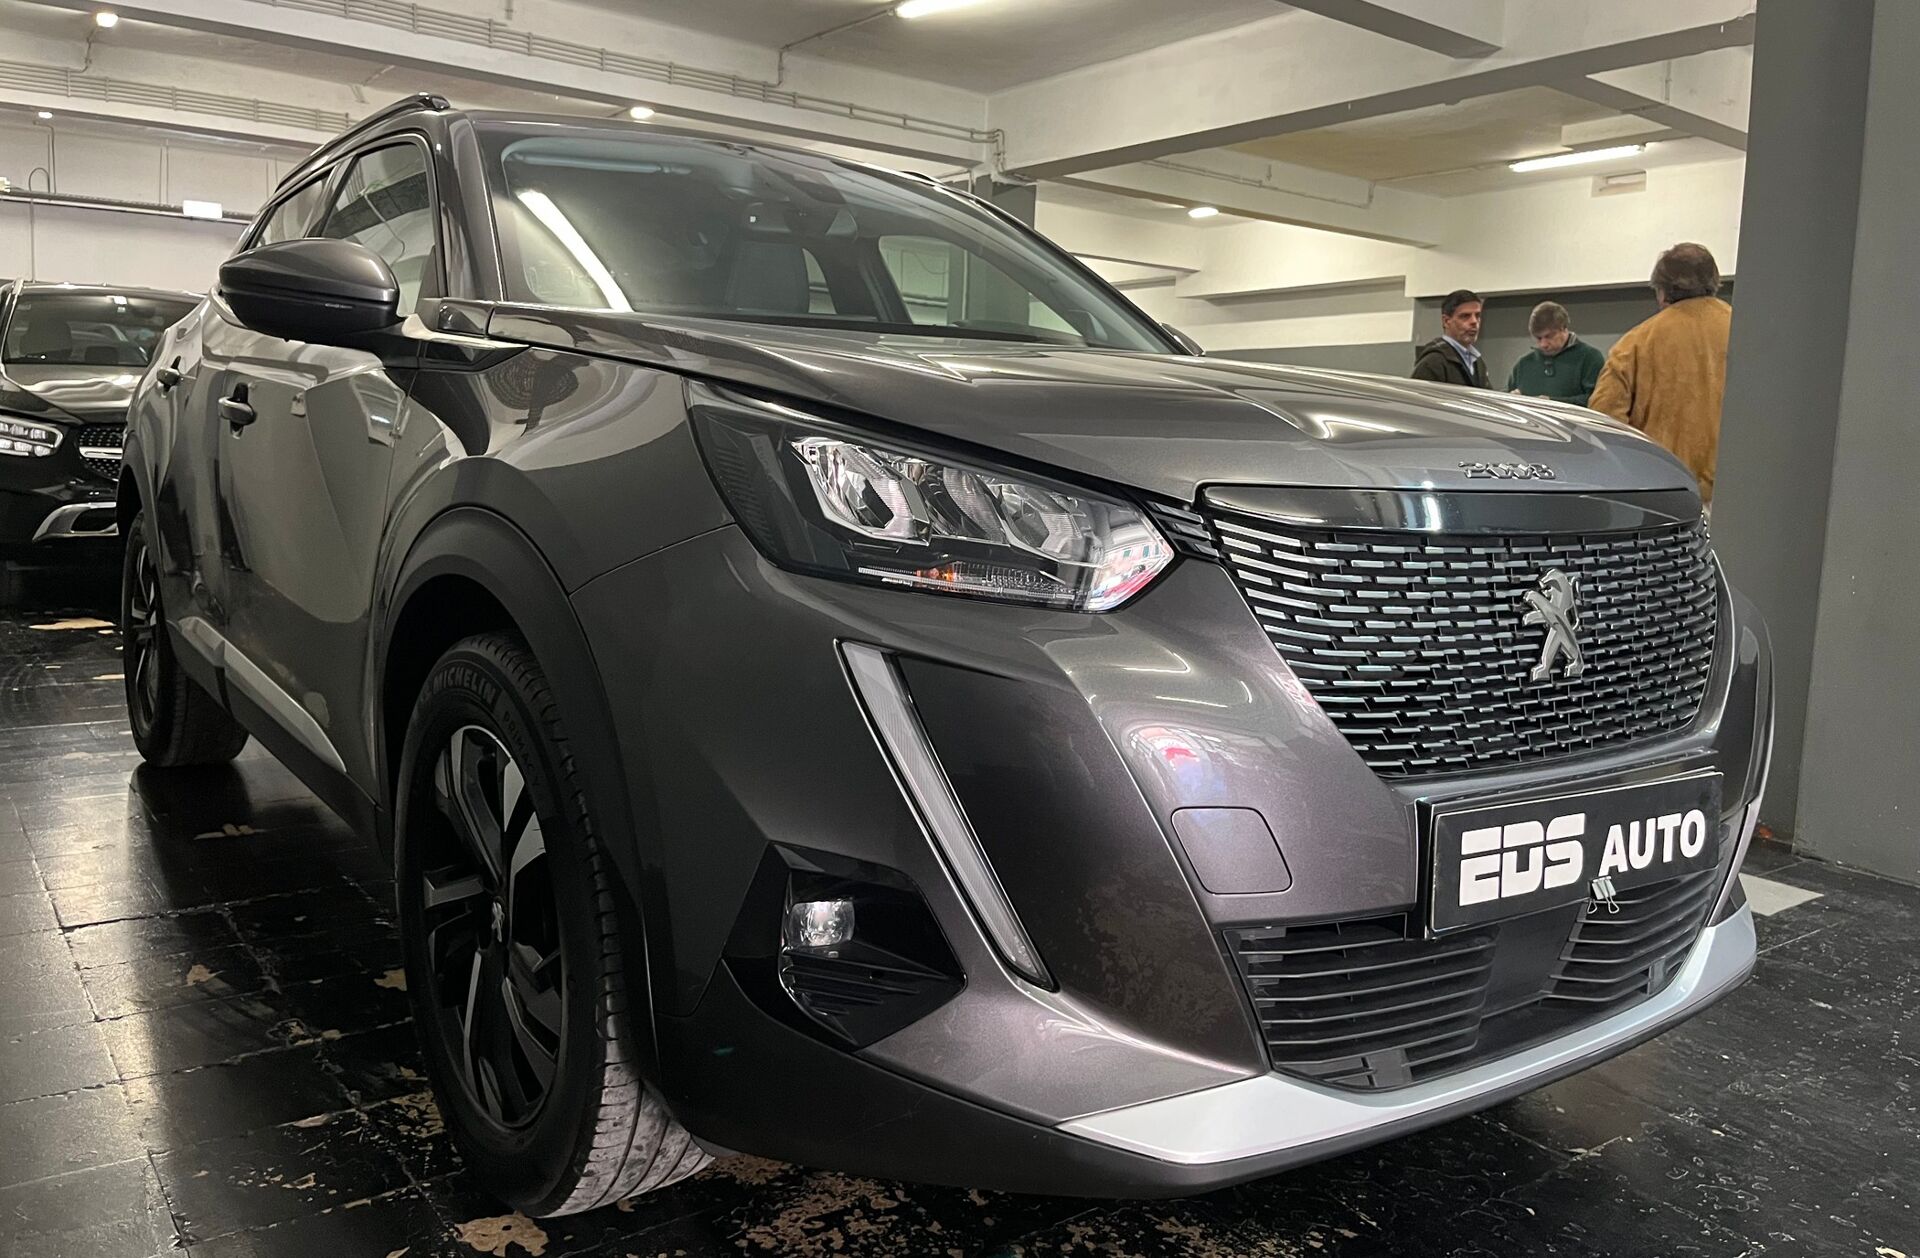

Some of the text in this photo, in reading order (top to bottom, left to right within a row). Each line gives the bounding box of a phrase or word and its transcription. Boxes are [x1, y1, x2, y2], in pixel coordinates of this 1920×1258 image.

[433, 666, 497, 704] MICHELIN
[1459, 808, 1706, 907] EDS AUTO
